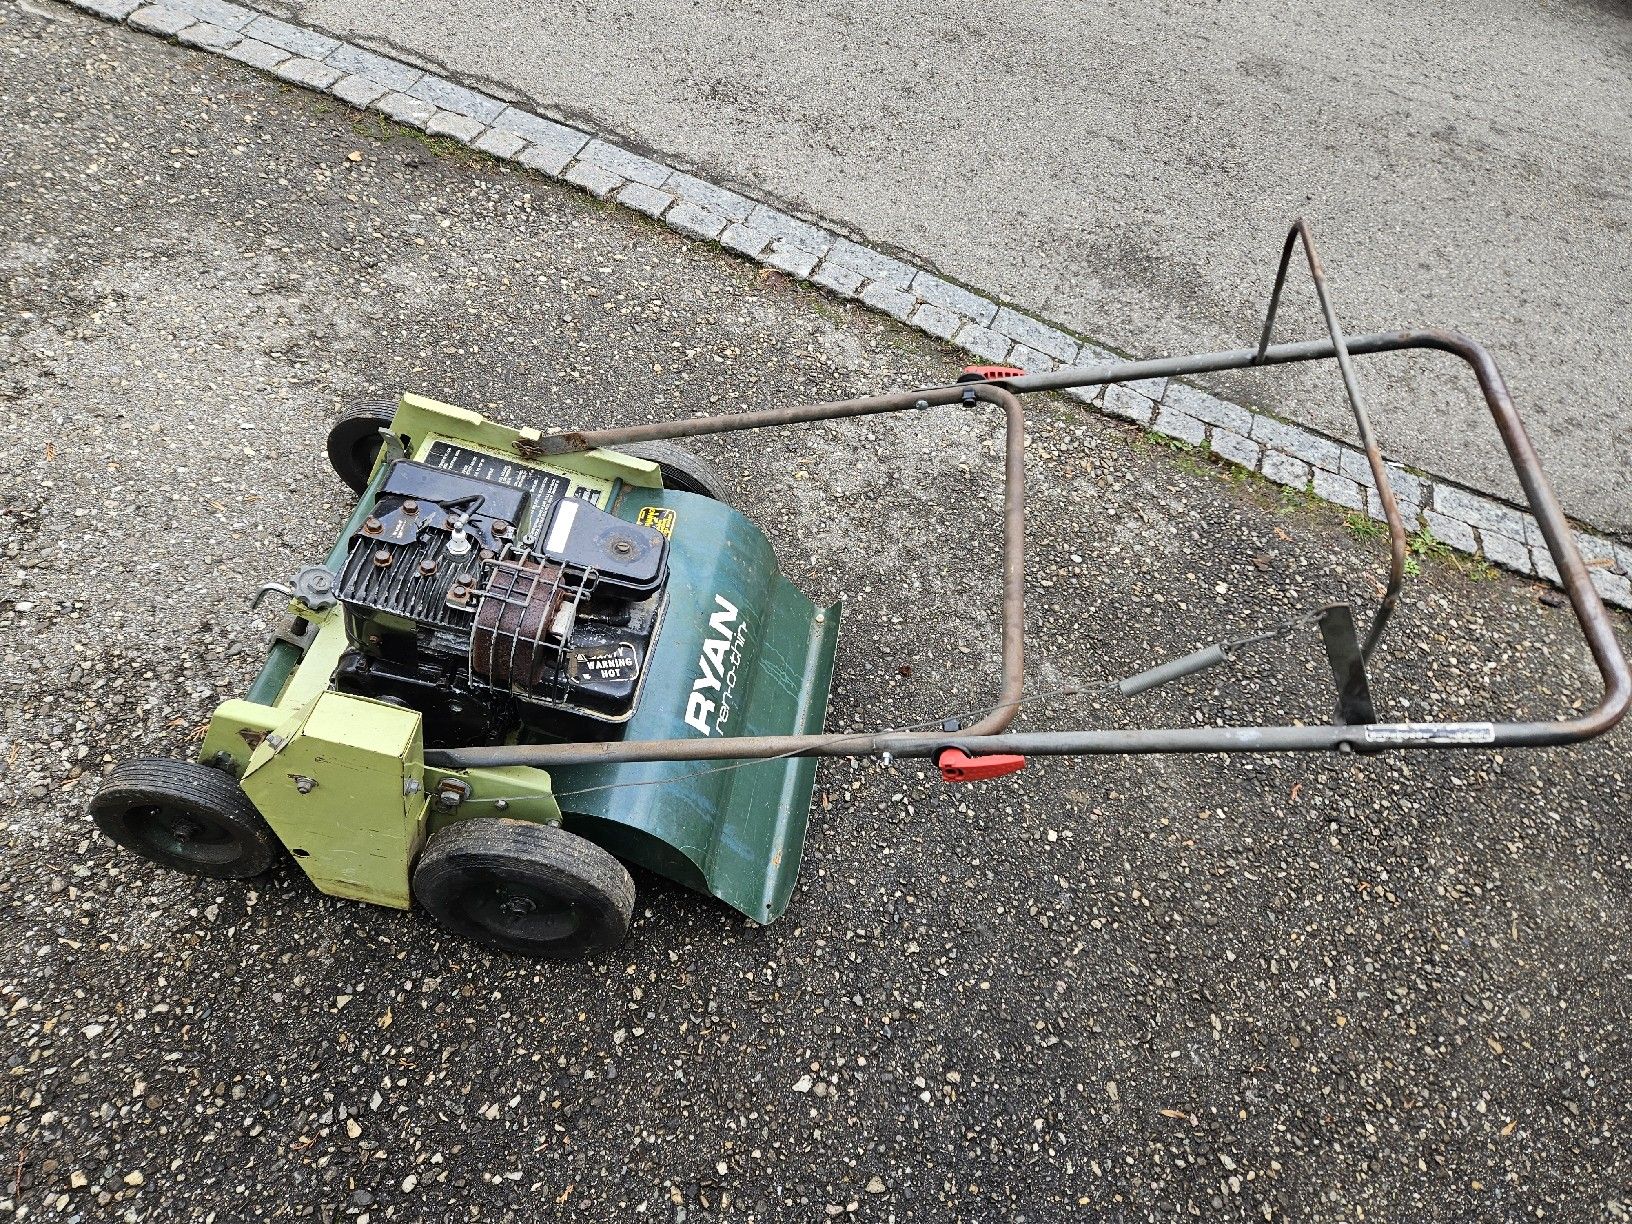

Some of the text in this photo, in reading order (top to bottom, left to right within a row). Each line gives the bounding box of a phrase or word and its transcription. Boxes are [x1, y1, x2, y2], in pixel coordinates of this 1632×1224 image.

[587, 658, 633, 670] WARNING
[600, 669, 621, 679] HOT
[684, 593, 739, 737] RYAN
[715, 621, 748, 736] ren-o-thin
